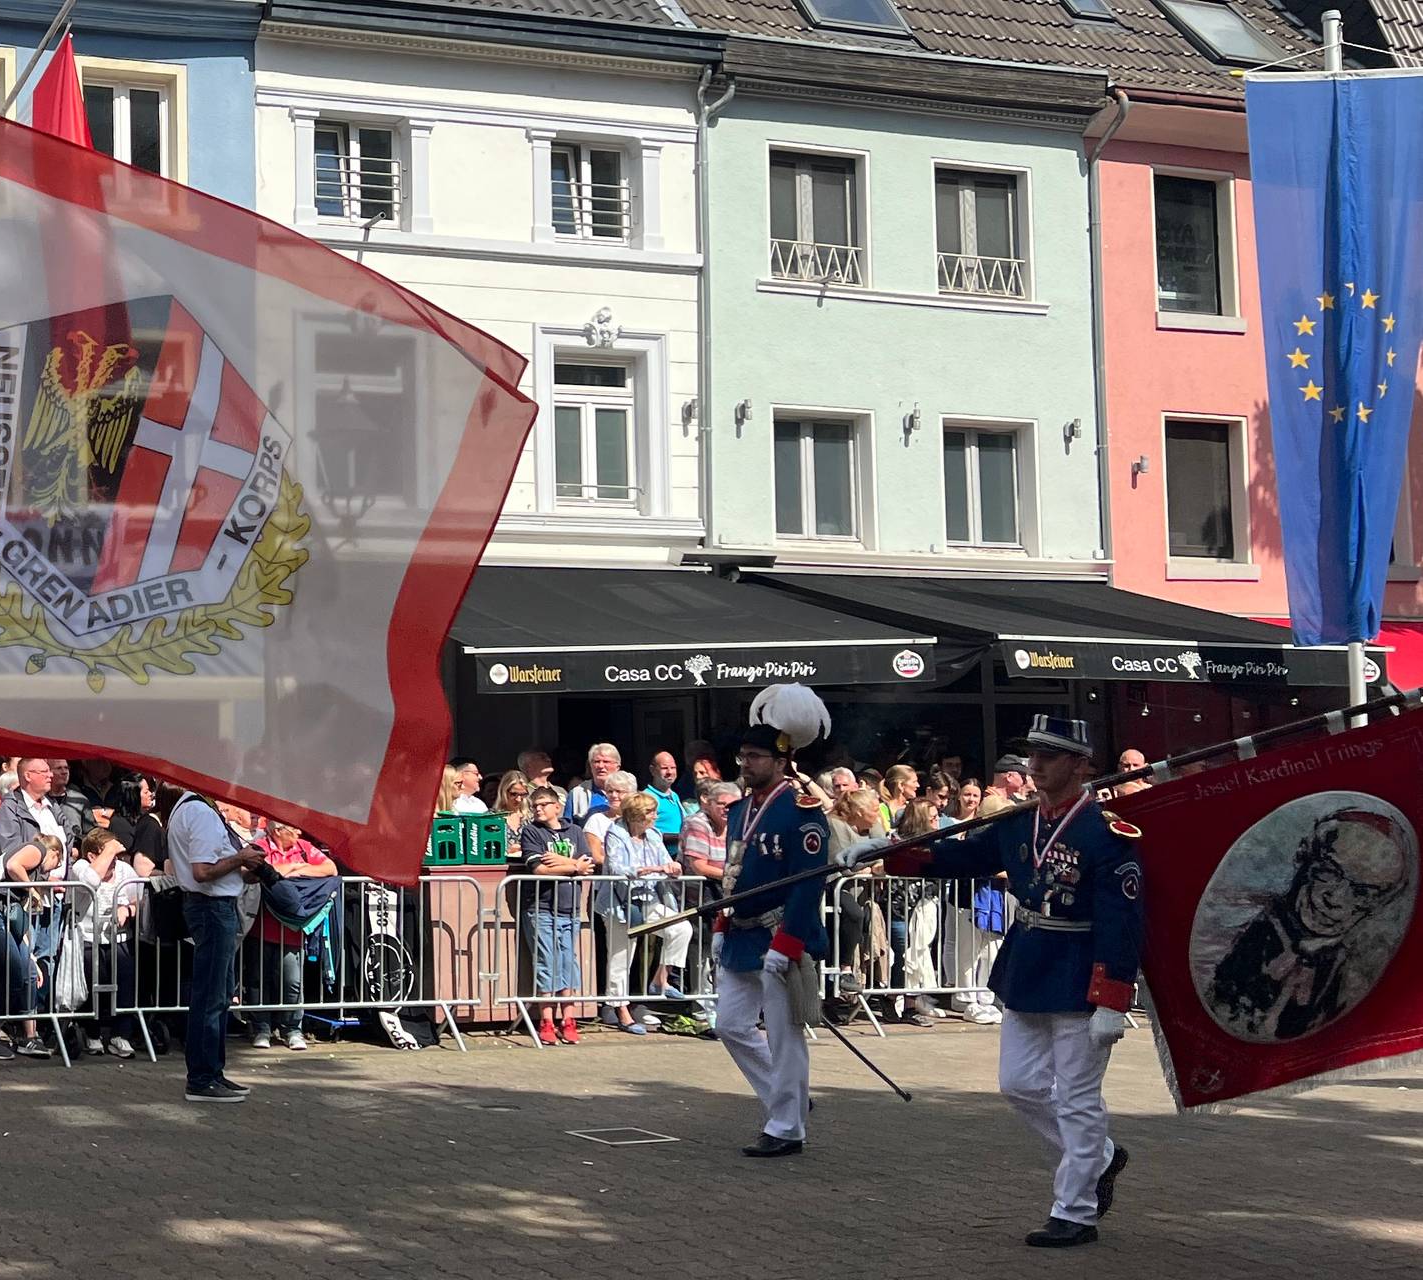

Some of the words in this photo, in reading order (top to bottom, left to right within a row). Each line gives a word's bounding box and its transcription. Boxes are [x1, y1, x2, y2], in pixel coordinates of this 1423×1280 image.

[2, 539, 193, 628] GRENADIER
[224, 435, 281, 545] KORPS
[1030, 651, 1075, 670] Warsteiner
[1112, 656, 1152, 672] Casa
[1154, 657, 1178, 673] CC
[1205, 660, 1245, 679] Frango
[1245, 661, 1266, 676] Piri
[1267, 661, 1290, 676] Piri
[509, 664, 562, 685] Warsteiner
[605, 665, 651, 682] Casa
[654, 664, 683, 680] CC
[716, 663, 764, 683] Frango
[765, 662, 791, 678] Piri
[791, 661, 817, 677] Piri
[1246, 753, 1322, 785] Kardinal
[1326, 739, 1384, 766] Frings
